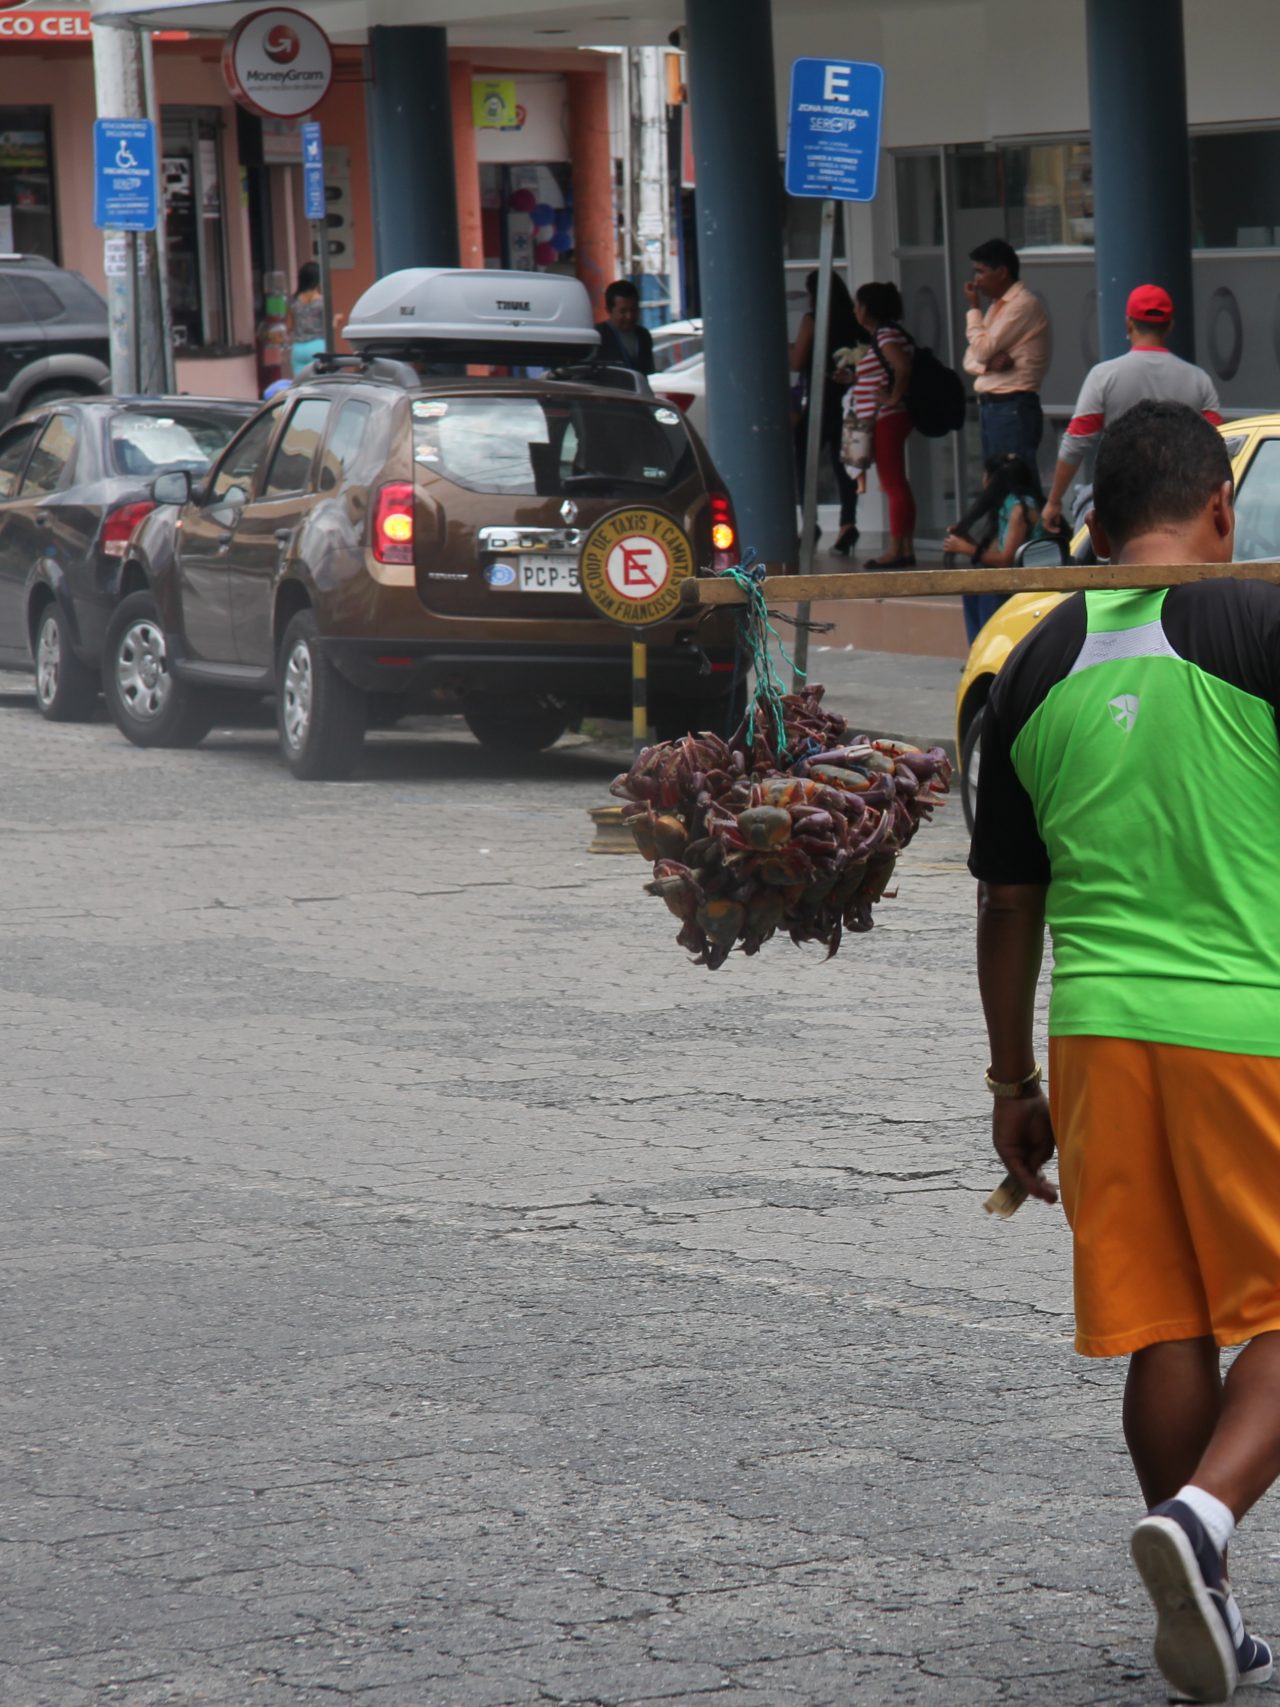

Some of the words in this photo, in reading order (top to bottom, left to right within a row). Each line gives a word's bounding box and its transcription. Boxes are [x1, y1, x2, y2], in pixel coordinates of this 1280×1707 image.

[246, 69, 325, 84] MoneyGram
[824, 66, 851, 102] E
[591, 529, 613, 551] DE
[651, 518, 663, 535] Y
